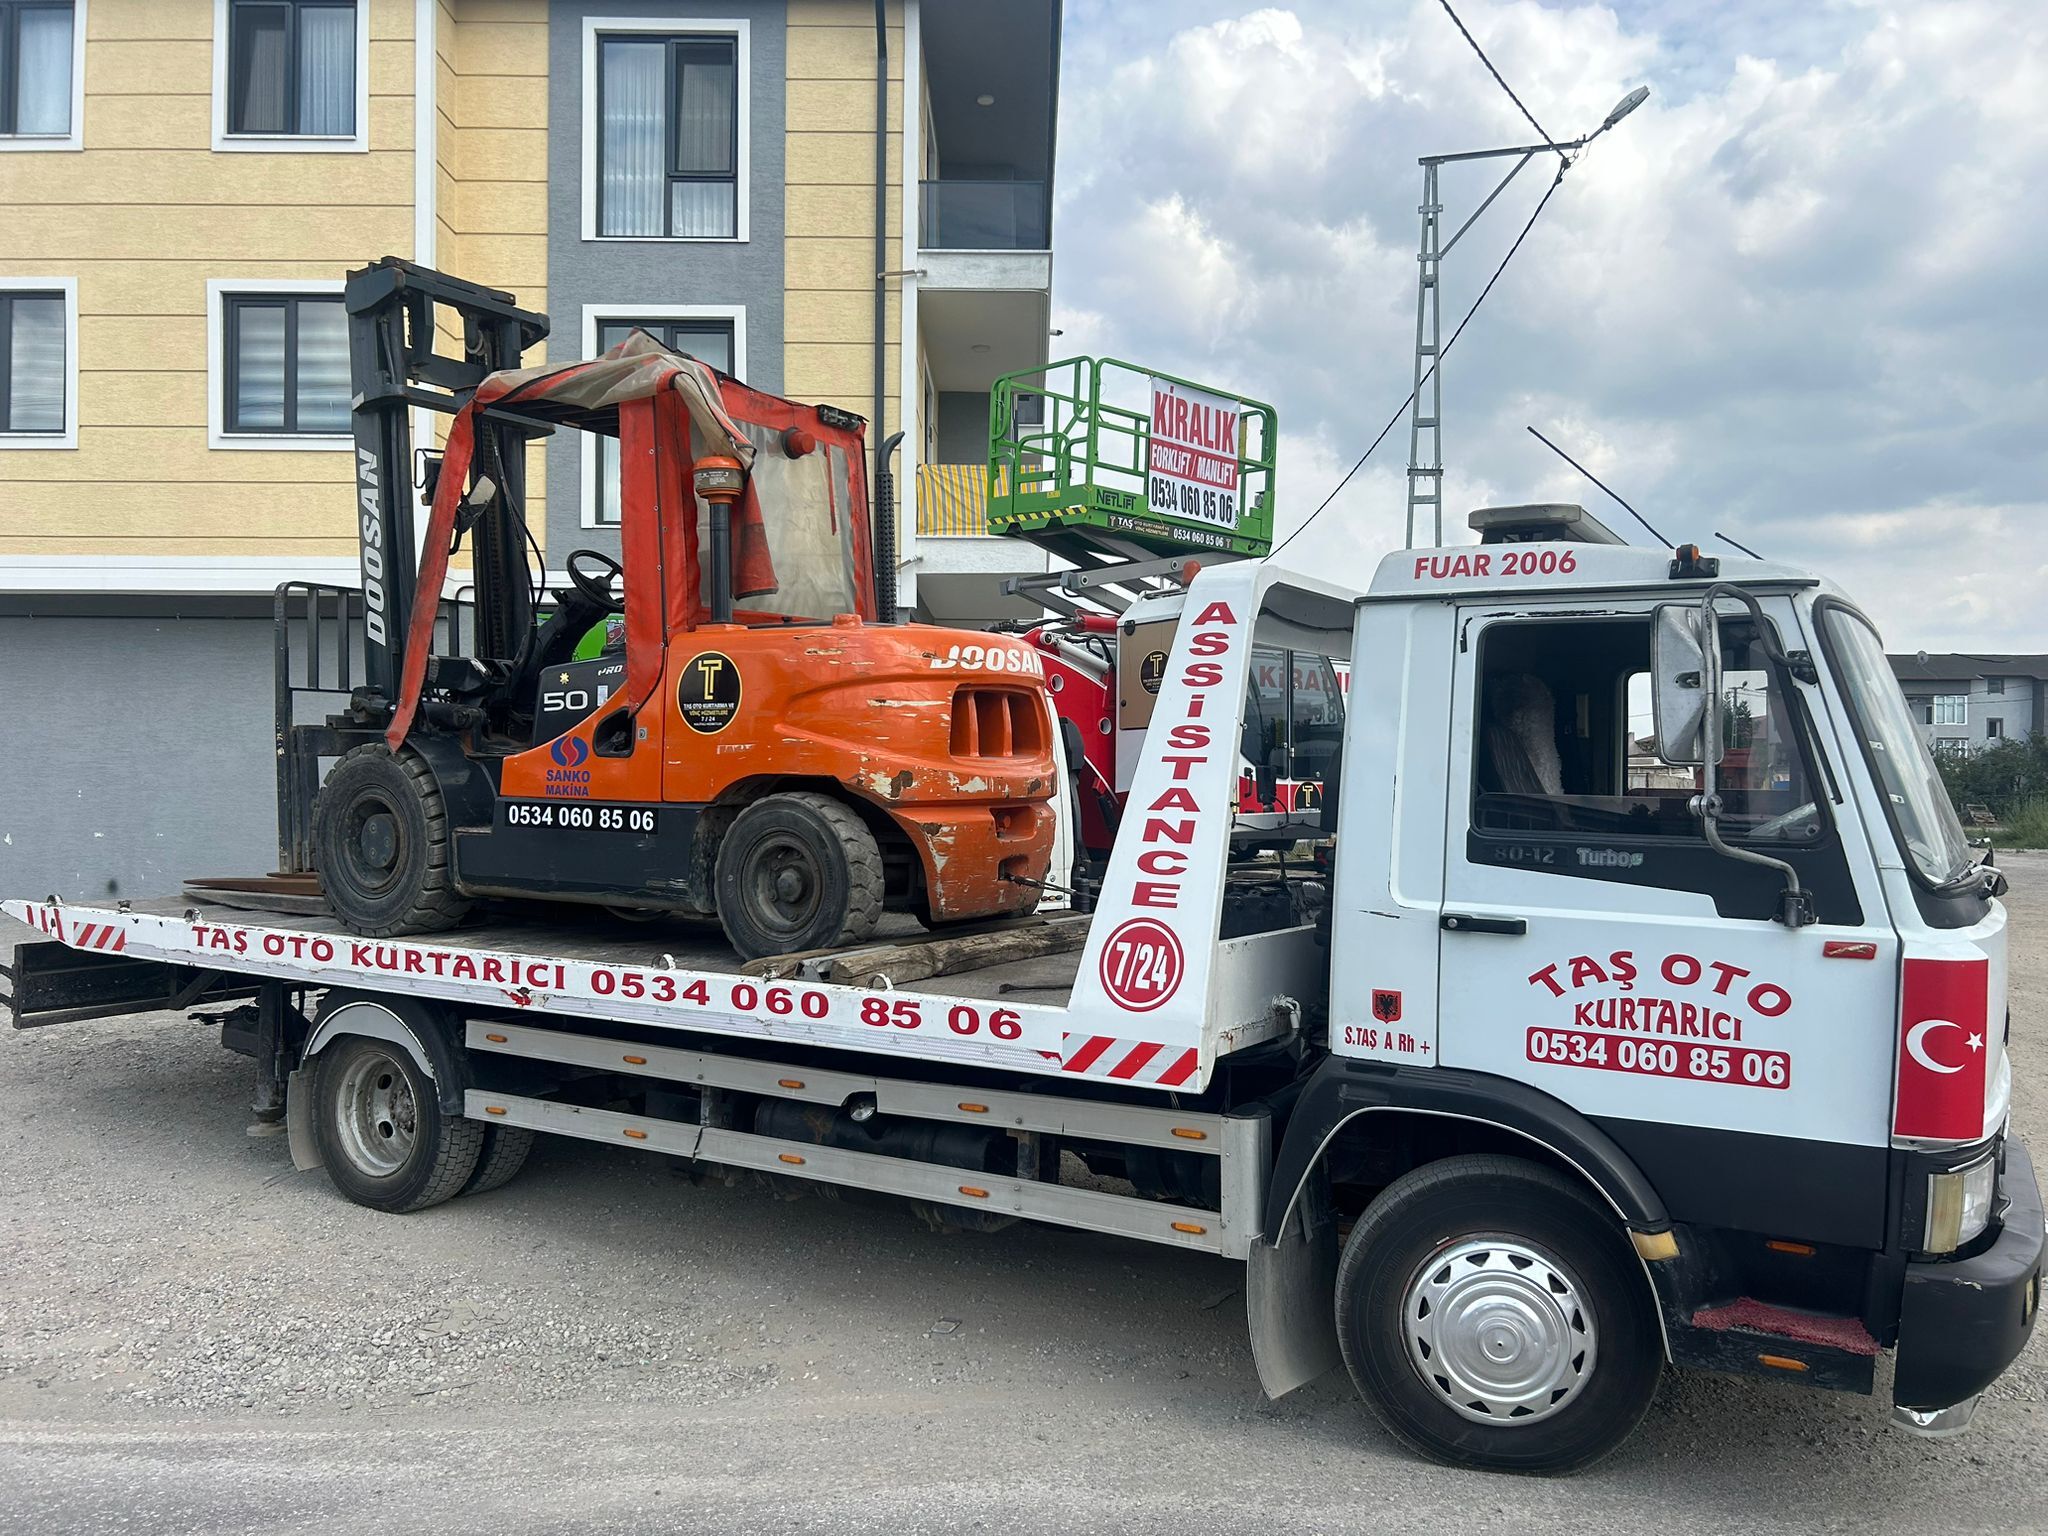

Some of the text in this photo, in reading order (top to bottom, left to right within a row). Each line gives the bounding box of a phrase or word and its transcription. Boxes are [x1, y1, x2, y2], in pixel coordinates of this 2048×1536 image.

[1154, 386, 1236, 454] KİRALIK
[1151, 477, 1233, 523] 0534 060 85 06
[1118, 516, 1133, 529] TAŞ
[1173, 528, 1224, 547] 0534 060 85 06
[358, 448, 386, 646] DOOSAN
[1414, 550, 1576, 579] FUAR 2006
[930, 645, 1043, 675] DOOSAN
[543, 690, 588, 711] 50
[545, 783, 589, 796] MAKİNA
[546, 769, 591, 783] SANKO
[508, 805, 654, 831] 0534 060 85 06
[1115, 941, 1168, 992] 7/24
[192, 926, 1023, 1040] TAŞ OTO KURTARICI 0534 060 85 06
[1528, 951, 1792, 1017] TAŞ OTO
[1574, 998, 1742, 1041] KURTARICI
[1345, 1026, 1377, 1050] S.TAŞ
[1384, 1031, 1393, 1050] A
[1399, 1033, 1415, 1053] Rh
[1531, 1031, 1785, 1085] 0534 060 85 06
